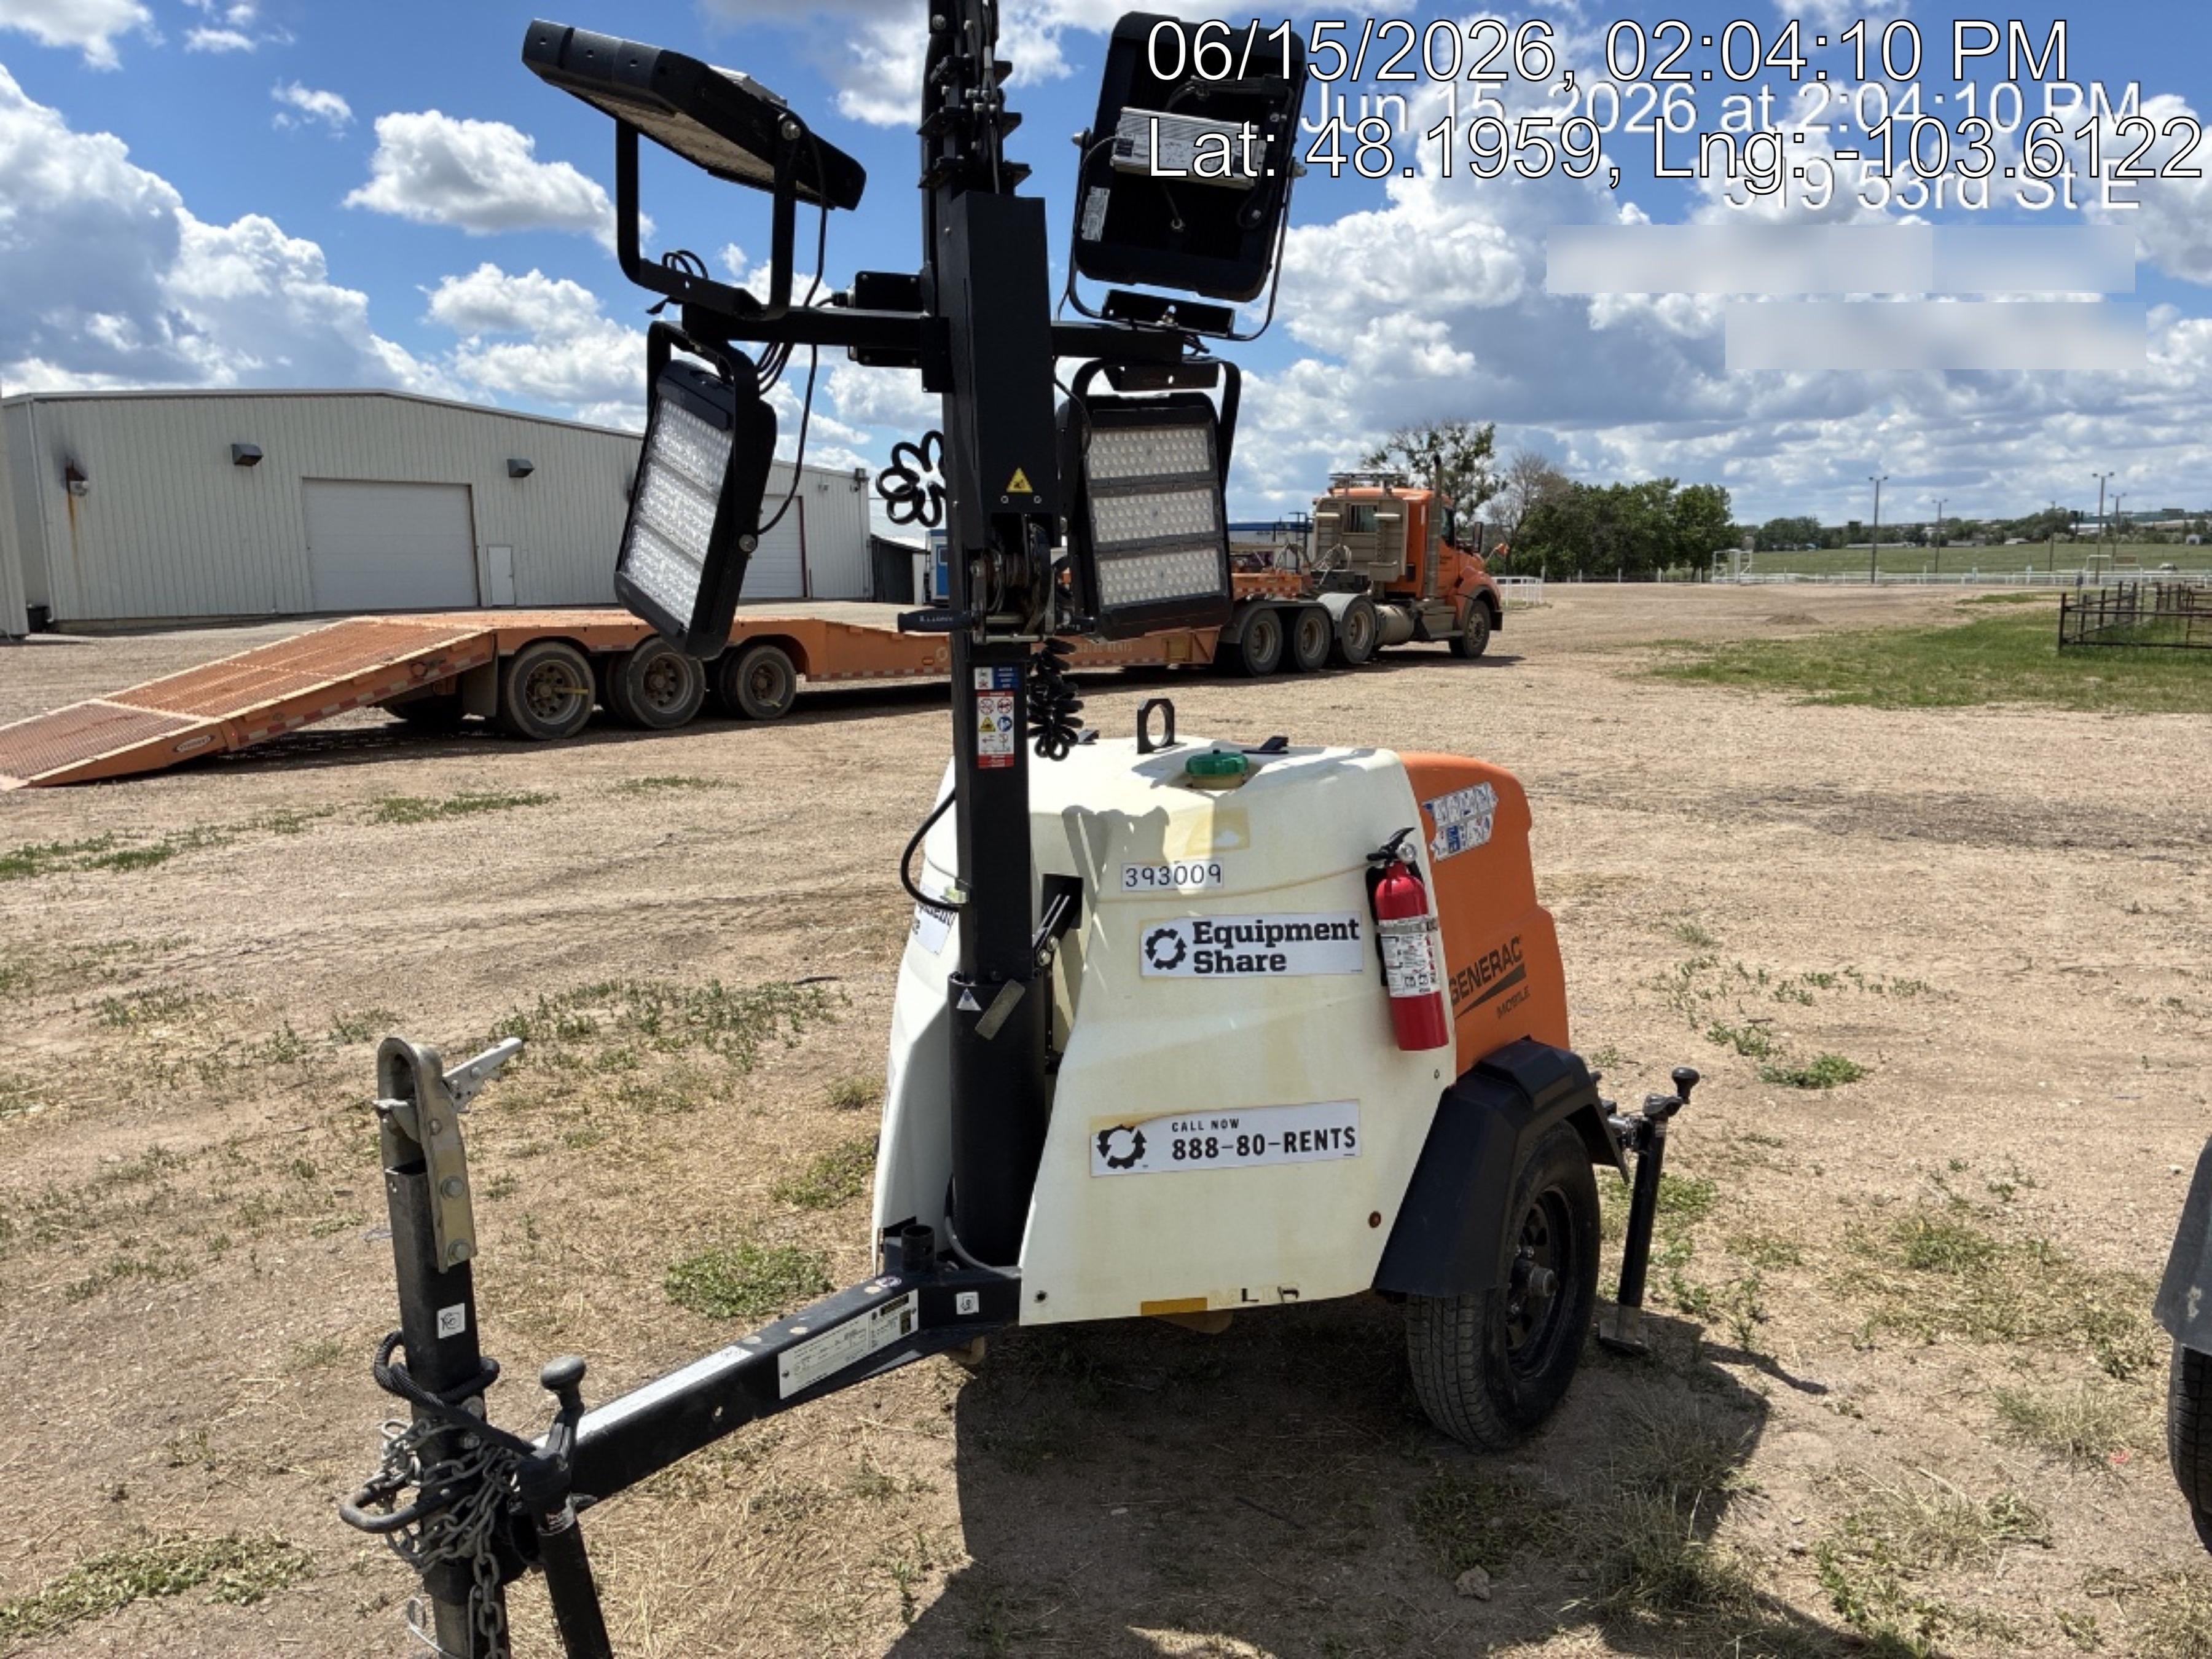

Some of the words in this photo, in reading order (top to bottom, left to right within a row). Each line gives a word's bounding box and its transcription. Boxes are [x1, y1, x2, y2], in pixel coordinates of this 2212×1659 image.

[1125, 864, 1221, 887] 393009
[1192, 919, 1360, 949] Equipment
[1193, 950, 1287, 974] Share
[1449, 935, 1523, 1006] GENERAC
[1171, 1120, 1204, 1132] CALL
[1211, 1118, 1239, 1130] NOW
[1171, 1126, 1356, 1161] 888-80-RENTS
